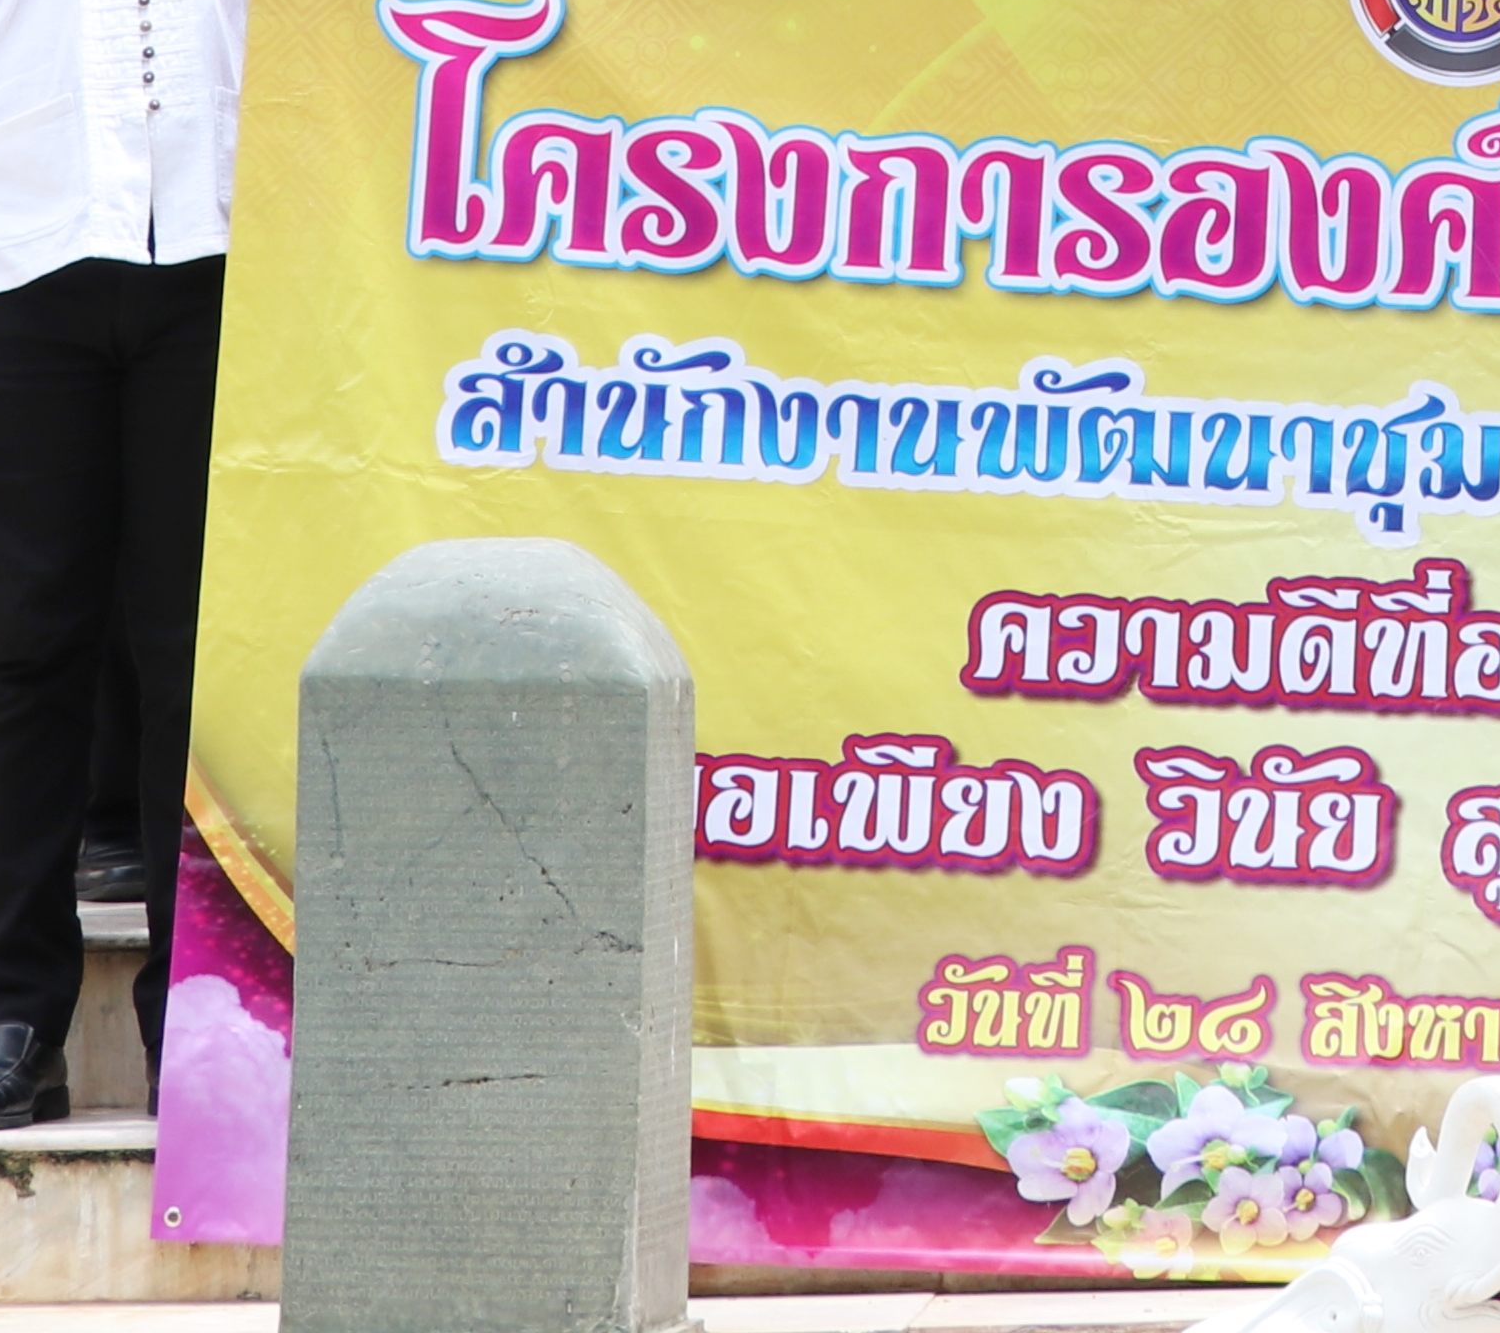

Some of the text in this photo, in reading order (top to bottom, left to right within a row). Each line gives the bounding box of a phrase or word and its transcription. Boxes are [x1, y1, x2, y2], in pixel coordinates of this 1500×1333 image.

[694, 743, 1083, 863] อเพียง
[1146, 754, 1384, 874] วินัย
[924, 954, 1086, 1051] วันที่
[1122, 979, 1268, 1054] ๒๘
